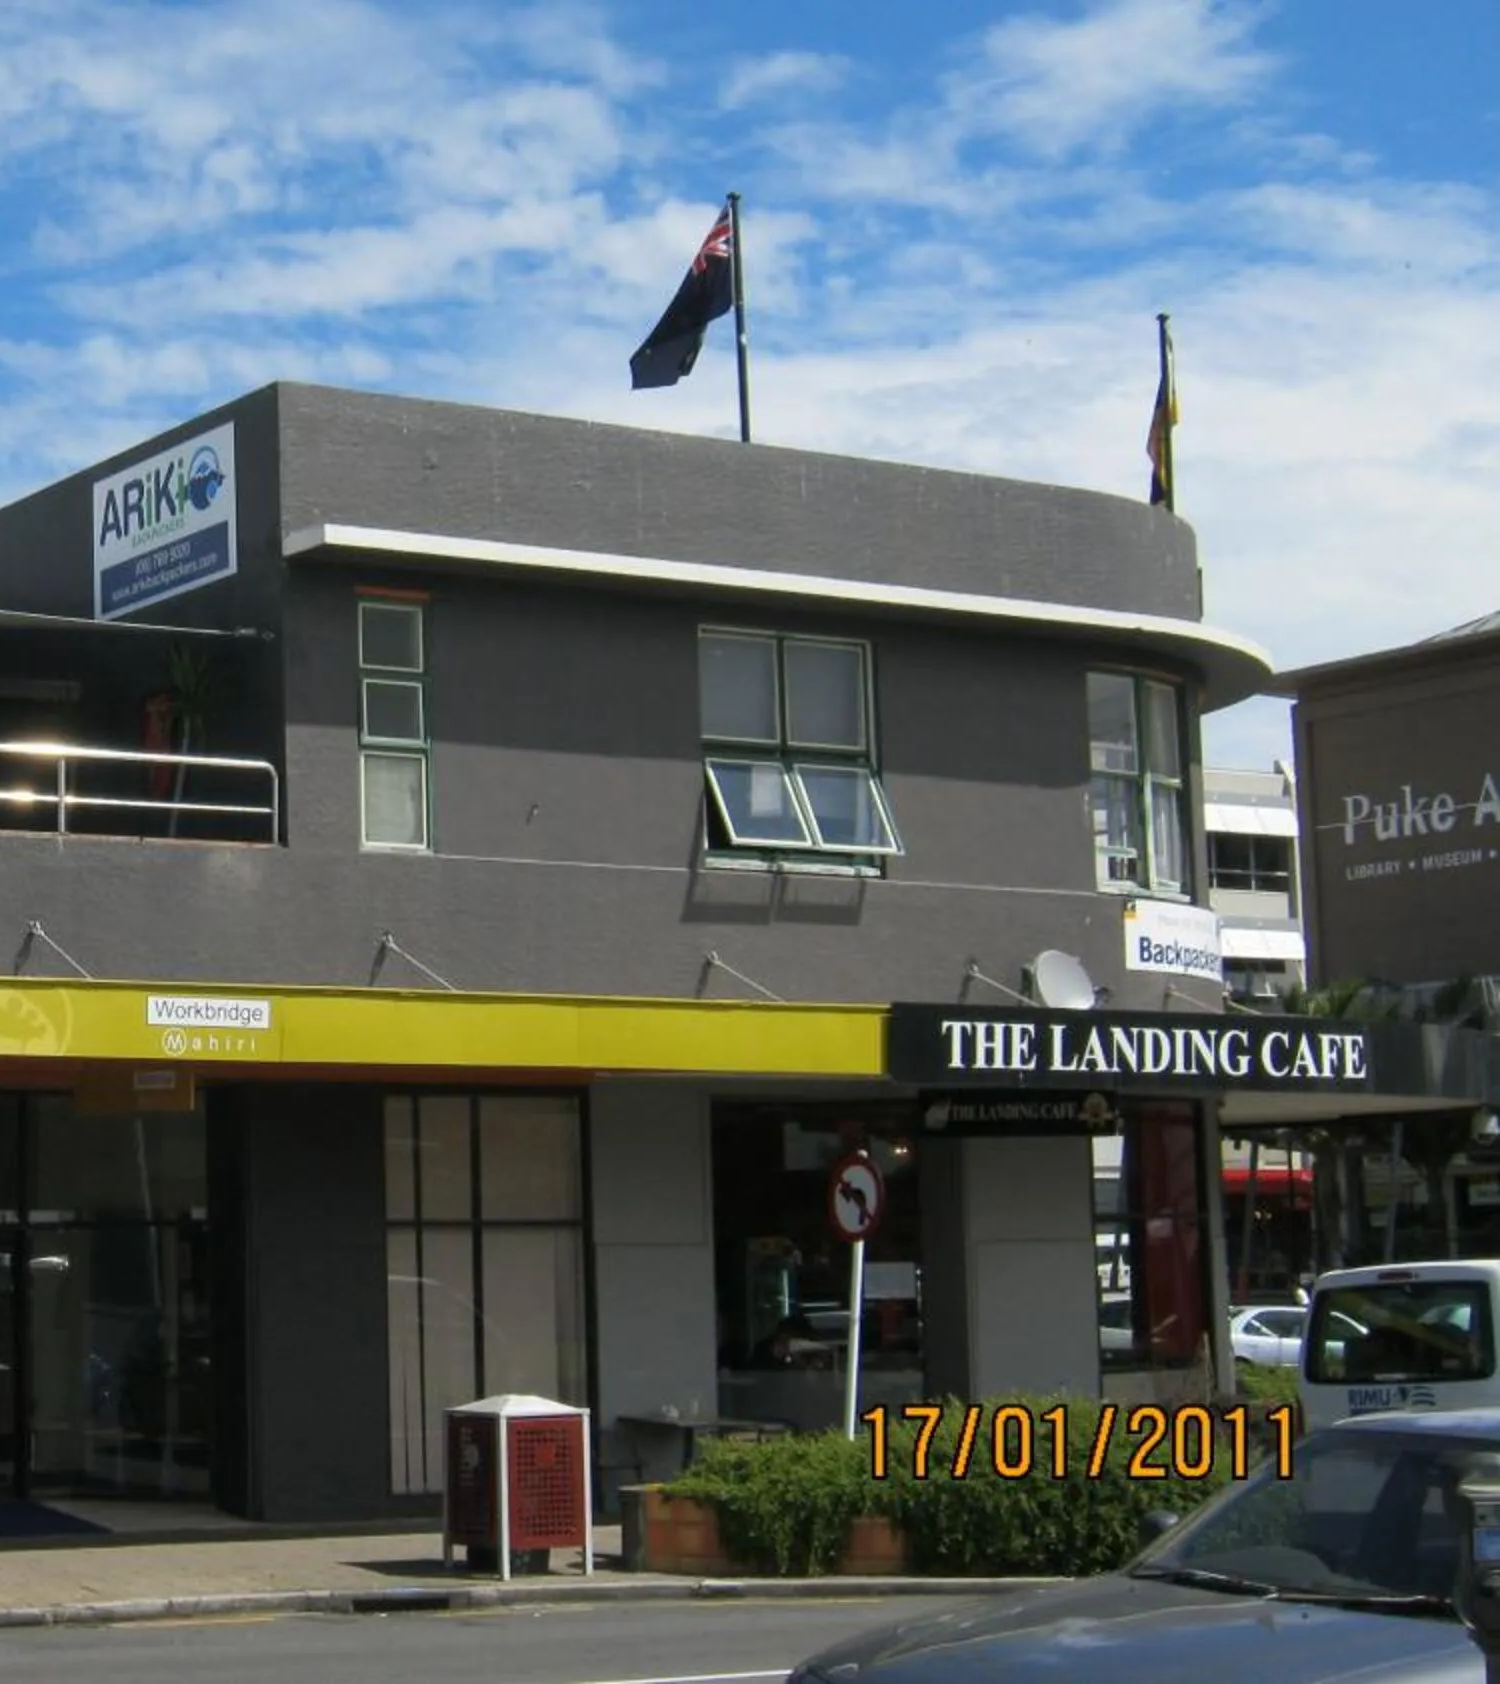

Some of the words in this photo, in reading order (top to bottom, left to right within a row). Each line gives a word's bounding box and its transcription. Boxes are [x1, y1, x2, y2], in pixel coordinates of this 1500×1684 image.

[1342, 784, 1457, 845] Puke
[1346, 862, 1400, 881] LIBRARY
[1422, 850, 1482, 872] MUSEUM
[155, 1000, 264, 1024] Workbridge
[942, 1020, 1037, 1071] THE
[1049, 1024, 1249, 1077] LANDING
[1260, 1031, 1368, 1079] CAFE
